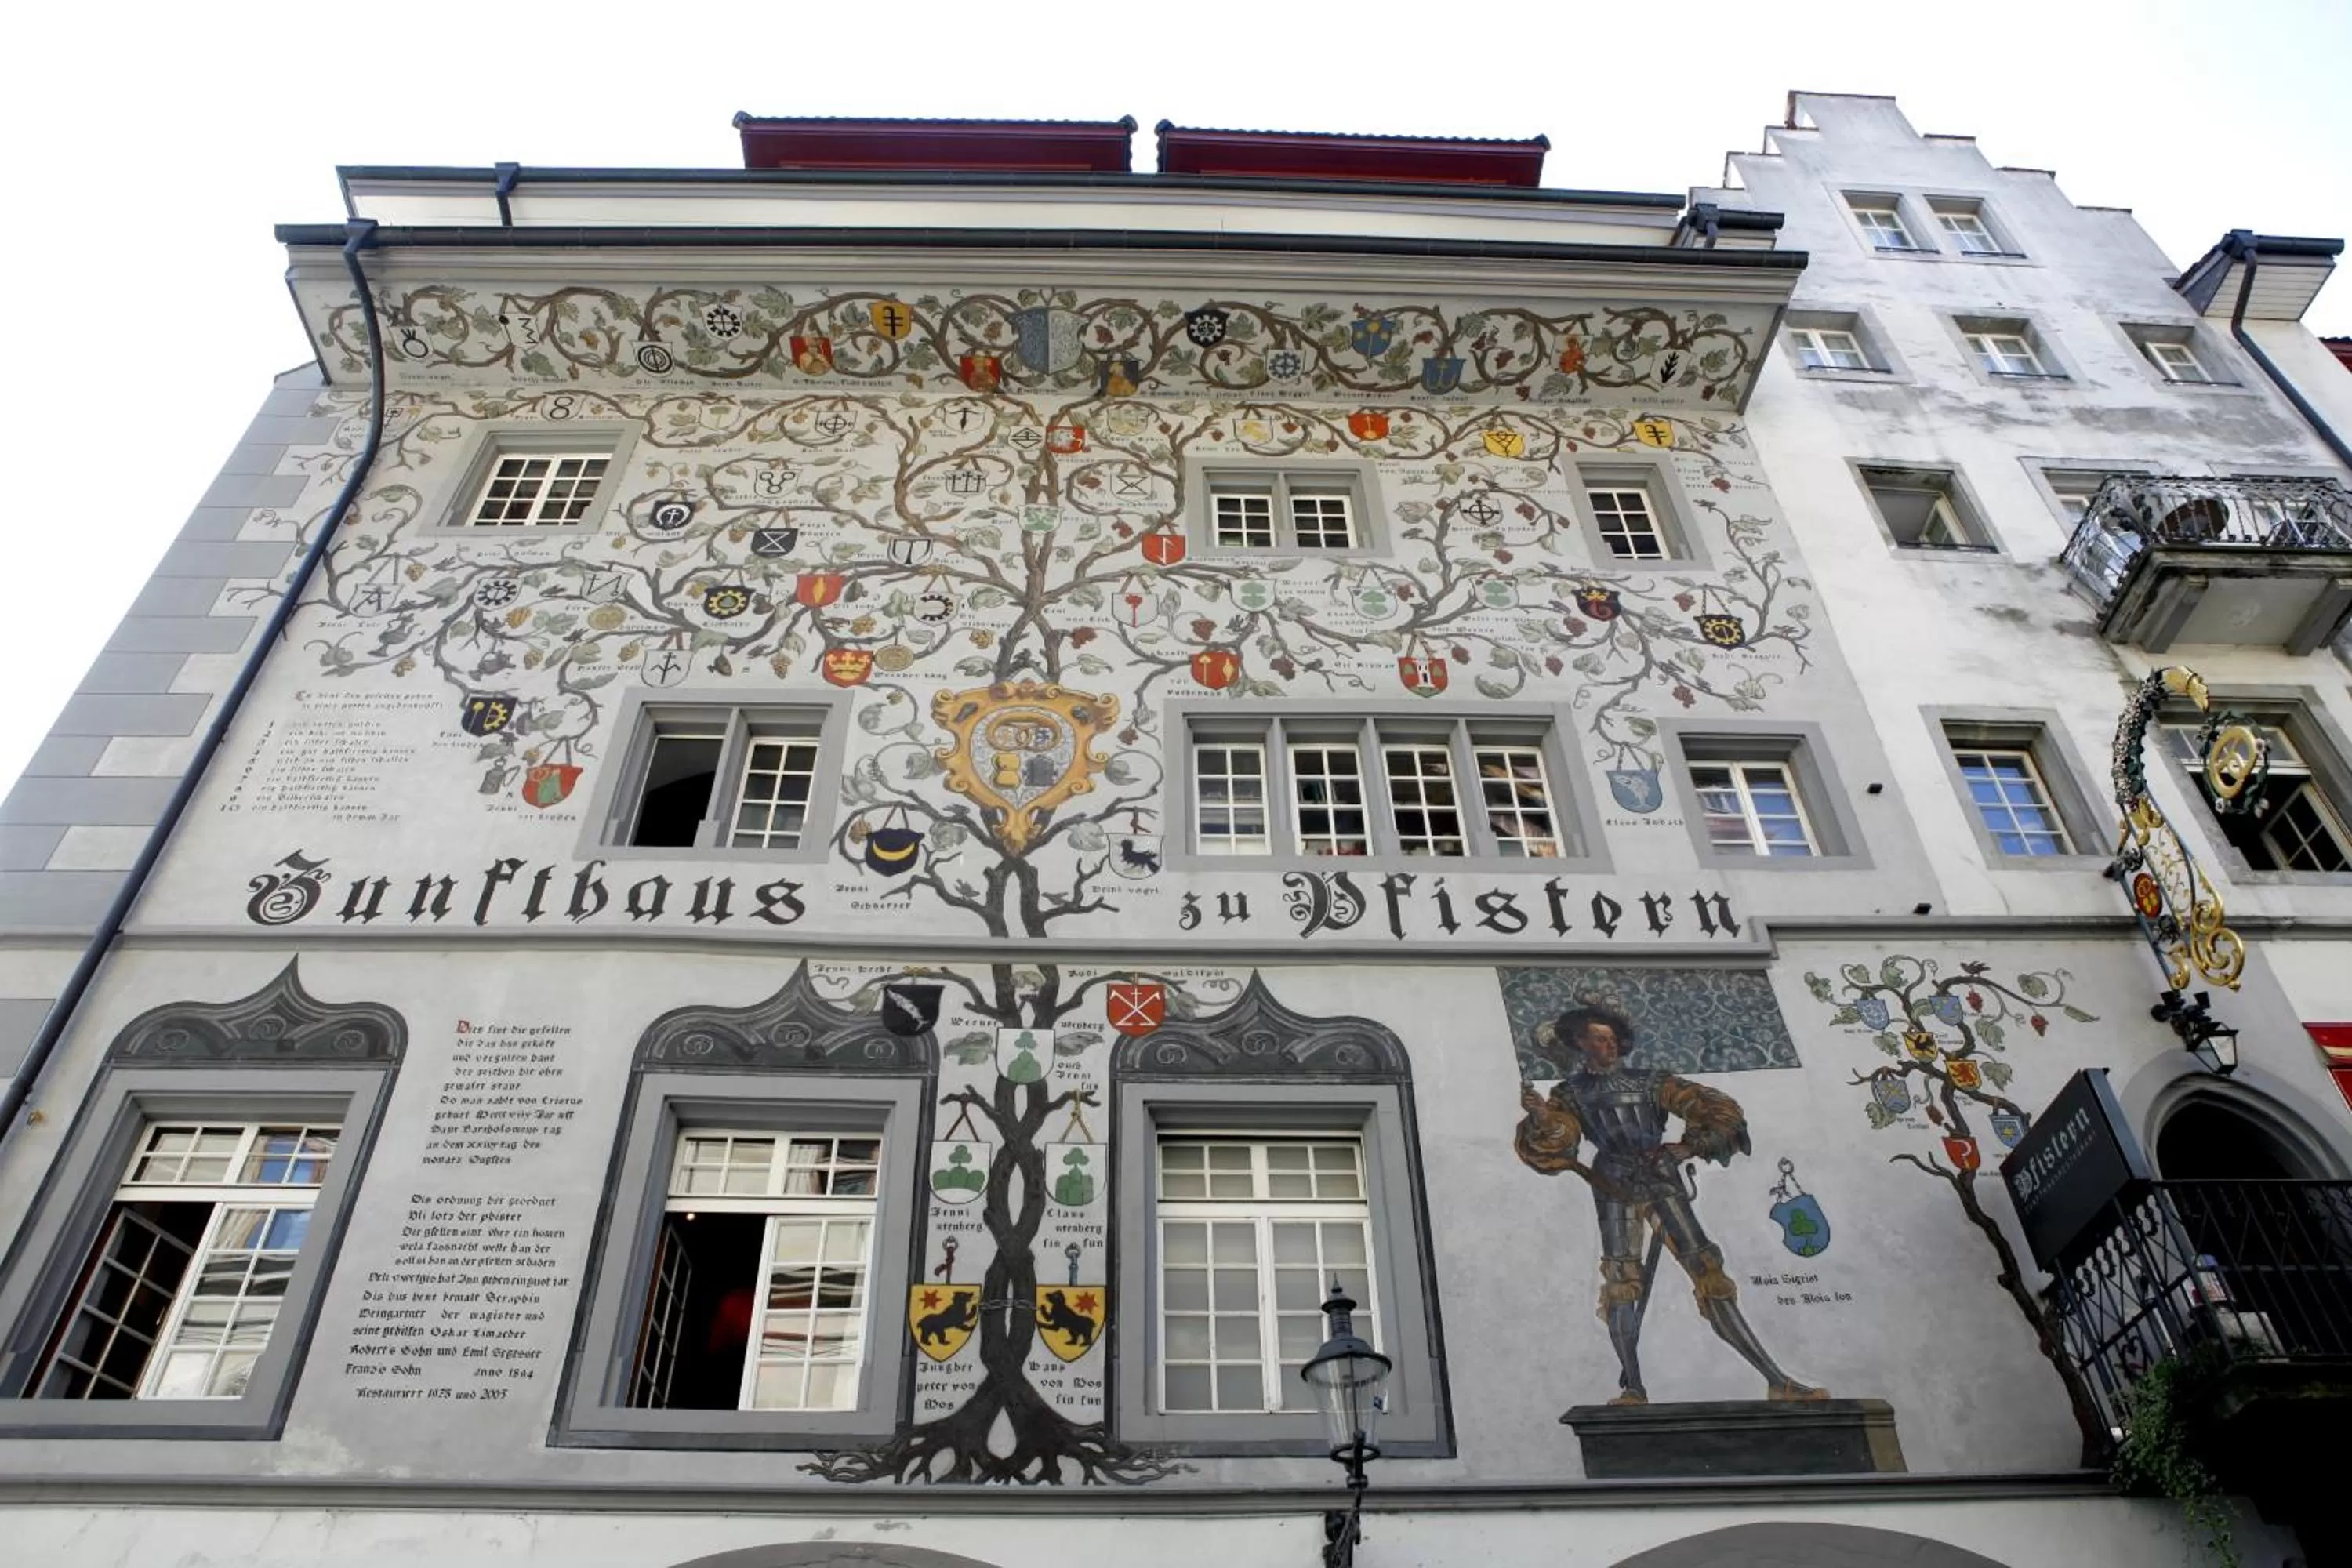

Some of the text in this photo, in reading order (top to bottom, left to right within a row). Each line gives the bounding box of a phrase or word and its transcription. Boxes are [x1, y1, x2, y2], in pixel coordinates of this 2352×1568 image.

[245, 848, 807, 927] Zunfthaus
[1178, 870, 1742, 940] zu Pfistern
[2014, 1105, 2092, 1202] Pfistern
